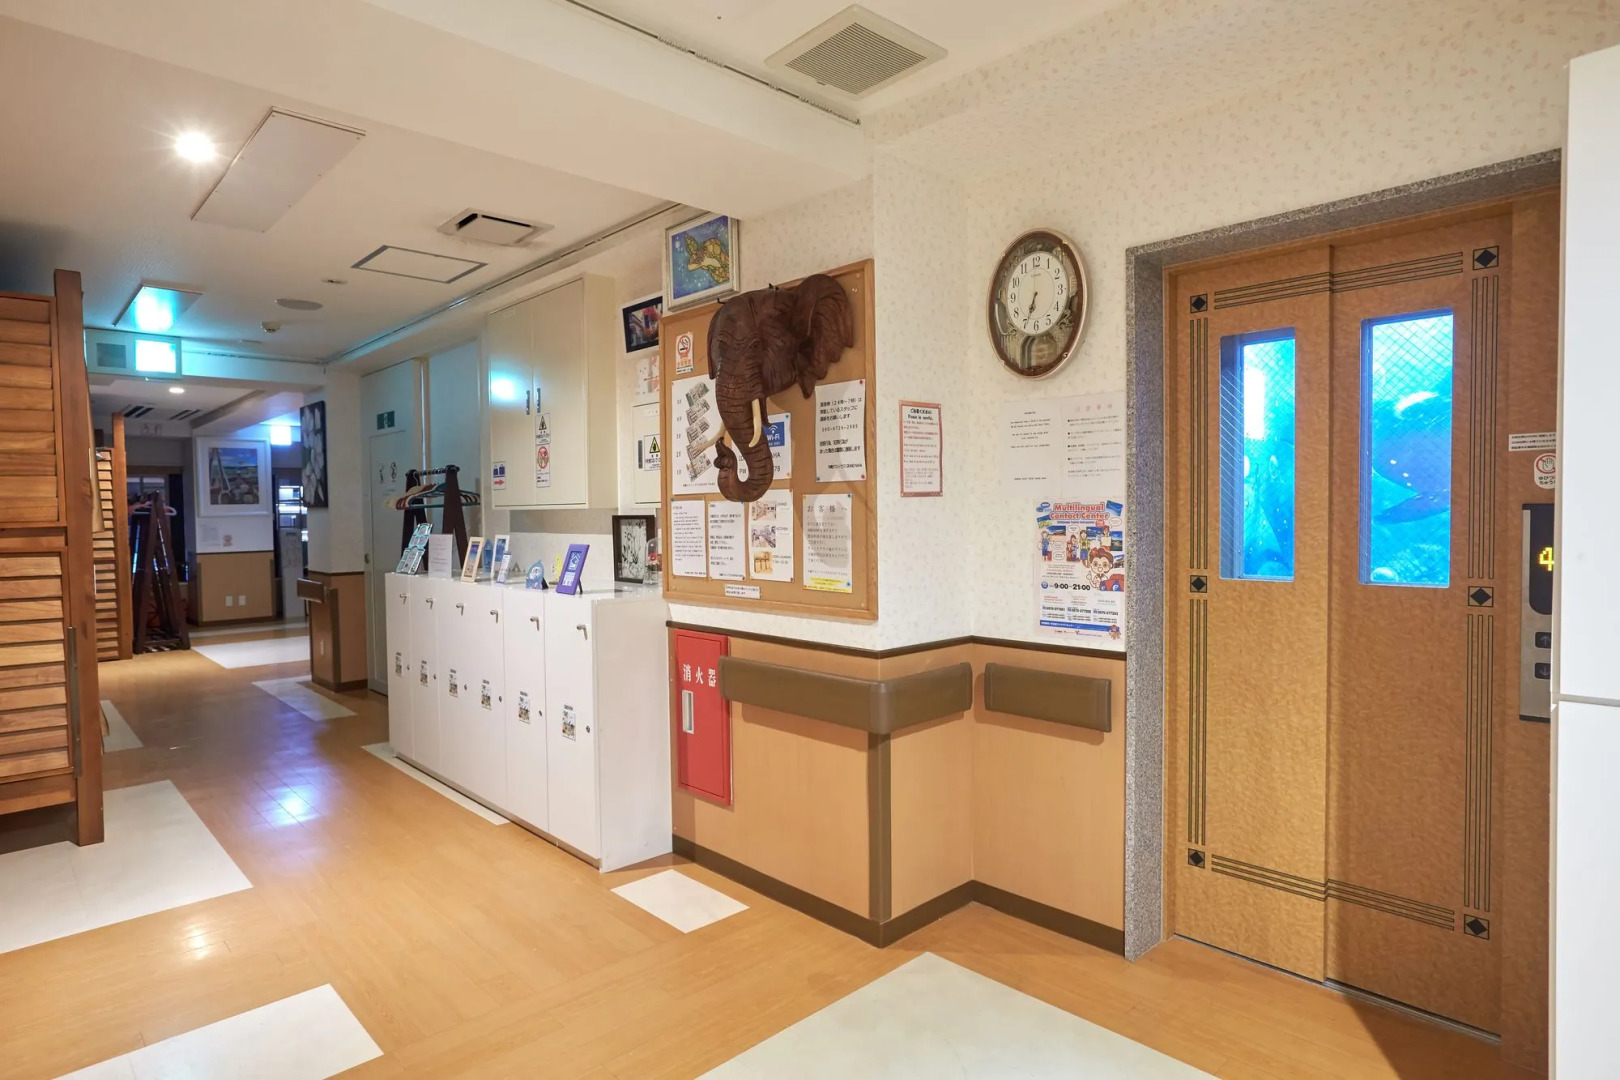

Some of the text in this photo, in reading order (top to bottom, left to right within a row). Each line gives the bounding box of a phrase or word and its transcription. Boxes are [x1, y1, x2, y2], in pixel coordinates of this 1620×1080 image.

[1032, 256, 1041, 268] 12
[1046, 257, 1050, 269] 1
[1020, 263, 1028, 274] 11
[1054, 268, 1060, 280] 2
[1012, 277, 1020, 288] 10
[1057, 283, 1064, 295] 3
[1010, 293, 1016, 303] 9
[1053, 300, 1060, 312] 4
[1013, 308, 1019, 318] 8
[1022, 318, 1028, 330] 7
[1033, 320, 1039, 332] 6
[1045, 314, 1052, 326] 5
[1054, 503, 1104, 512] Multilingual
[1050, 512, 1109, 520] Contact Center
[1539, 547, 1555, 571] 4
[683, 663, 717, 687] 消火器
